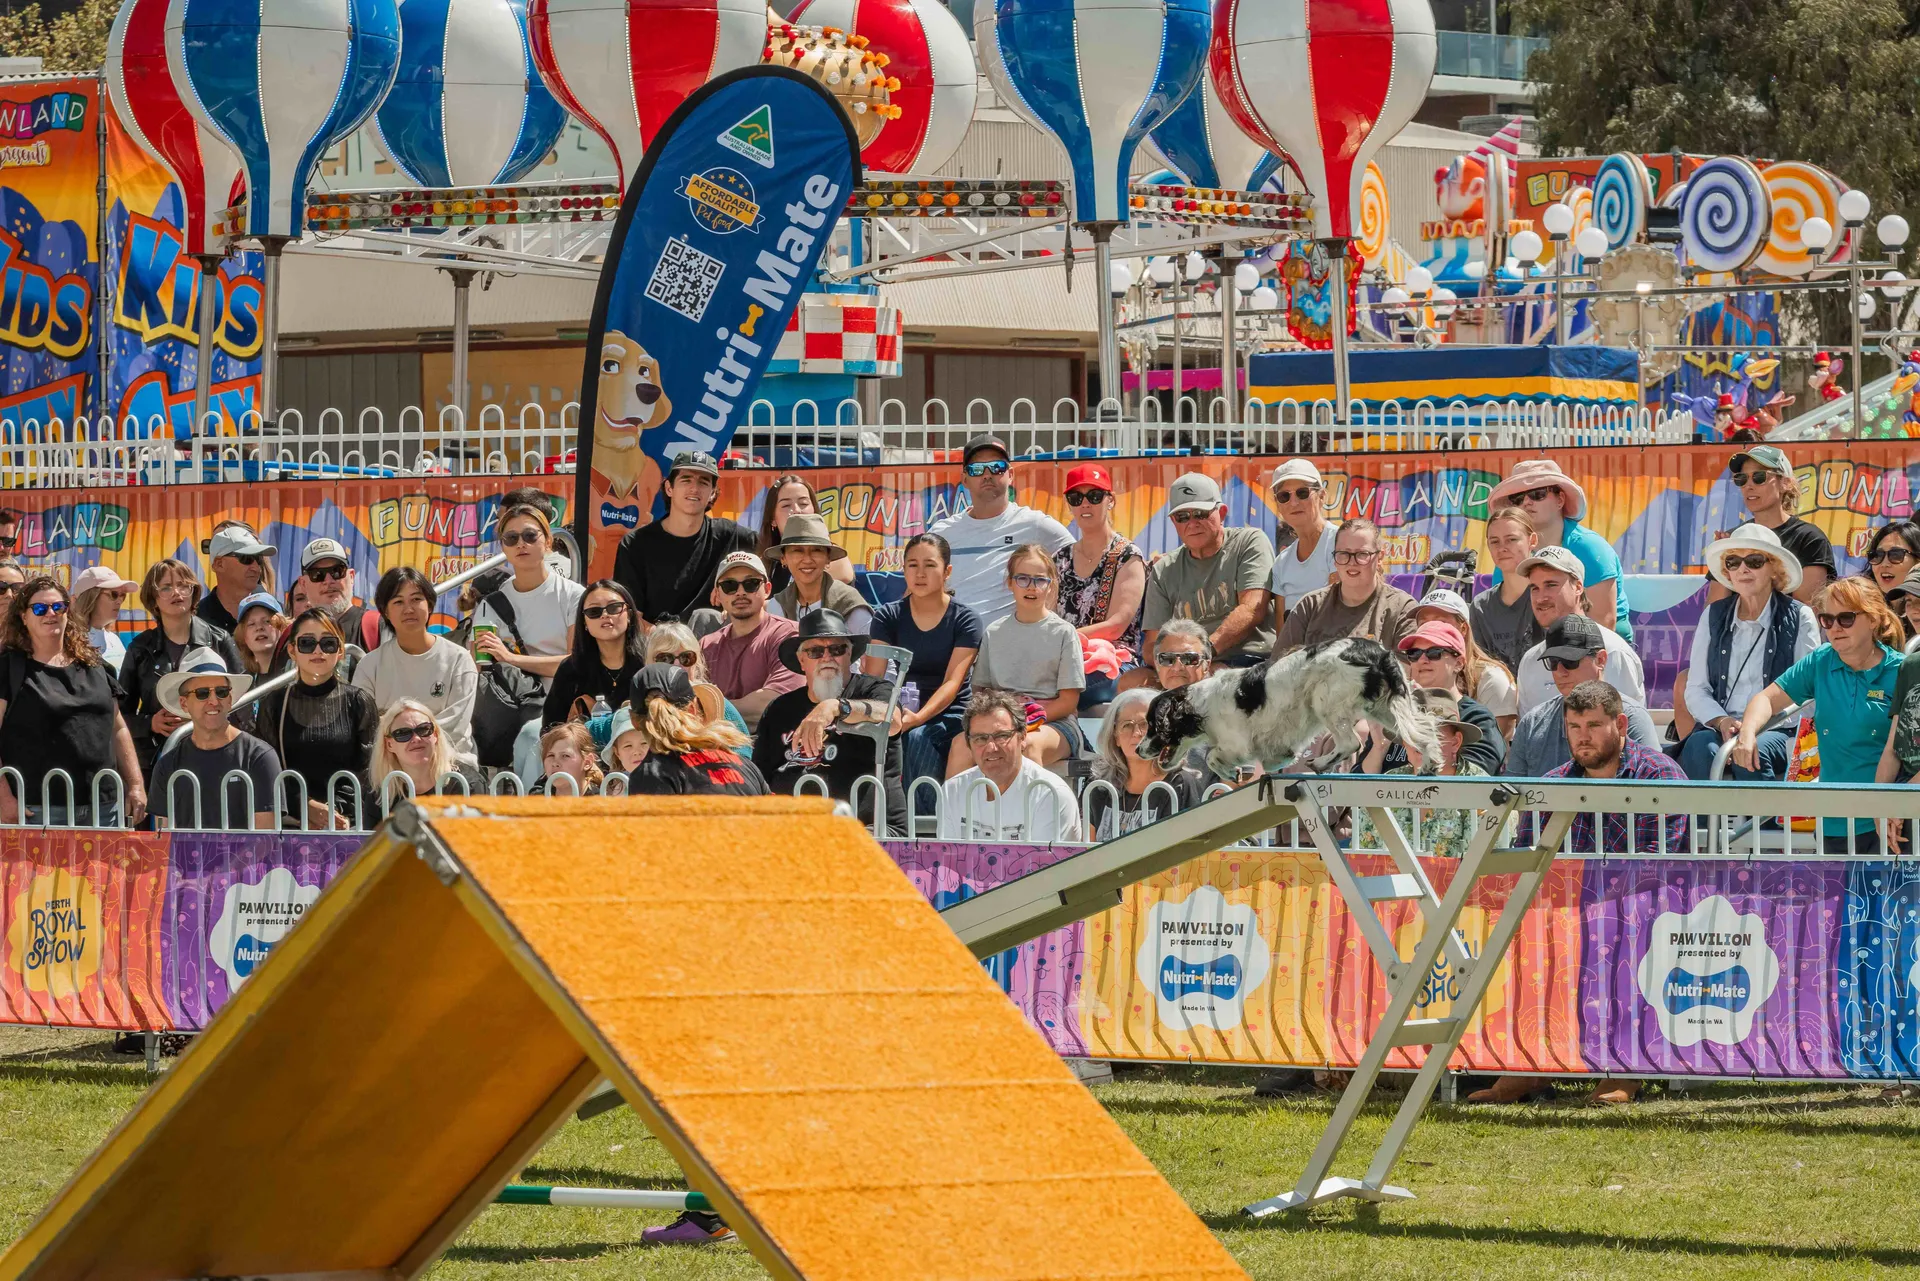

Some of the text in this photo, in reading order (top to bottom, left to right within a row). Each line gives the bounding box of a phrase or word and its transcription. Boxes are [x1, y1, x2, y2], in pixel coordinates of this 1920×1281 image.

[723, 134, 772, 161] AUSTRALIAN MADE
[729, 143, 742, 152] AND
[692, 179, 756, 215] AFFORDABLE
[699, 191, 742, 216] QUALITY
[695, 203, 736, 231] Pet food
[1376, 789, 1431, 800] GALICAN
[1525, 789, 1548, 806] B2
[1485, 815, 1500, 831] B2
[45, 898, 71, 910] PERTH
[30, 907, 86, 944] ROYAL
[246, 917, 290, 926] presented
[1162, 921, 1244, 936] PAWVILION
[1170, 938, 1233, 949] presented by
[1669, 932, 1752, 946] PAWVILION
[25, 937, 85, 970] SHOW
[1677, 949, 1741, 960] presented by
